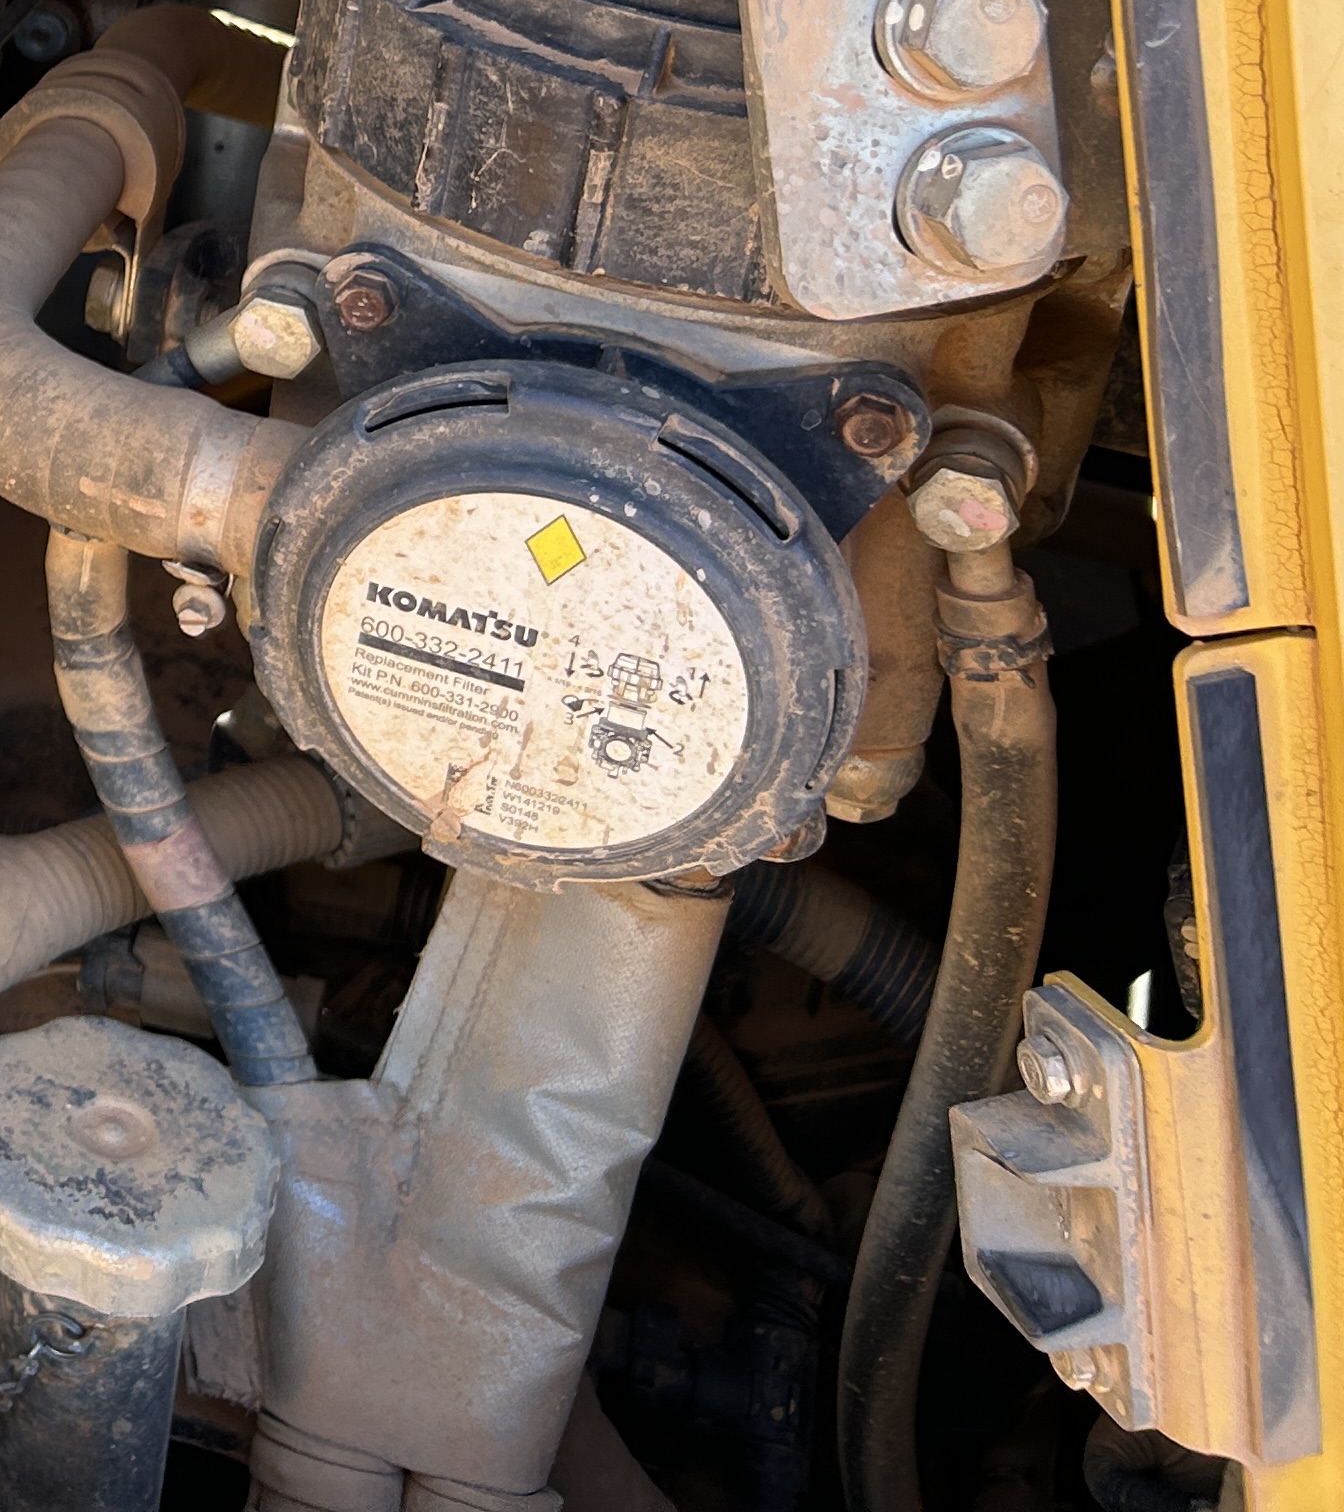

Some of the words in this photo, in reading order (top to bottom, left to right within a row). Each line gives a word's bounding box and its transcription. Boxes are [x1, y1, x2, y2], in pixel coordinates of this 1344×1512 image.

[365, 580, 539, 648] KOMATSU
[360, 615, 525, 679] 600-332-2411
[568, 634, 581, 648] 4
[354, 646, 449, 685] Replacement
[452, 676, 491, 697] Filter
[351, 661, 373, 679] Kit
[411, 680, 519, 723] 600-331-2900
[393, 700, 426, 718] issued
[563, 711, 575, 726] 3
[672, 742, 685, 757] 2
